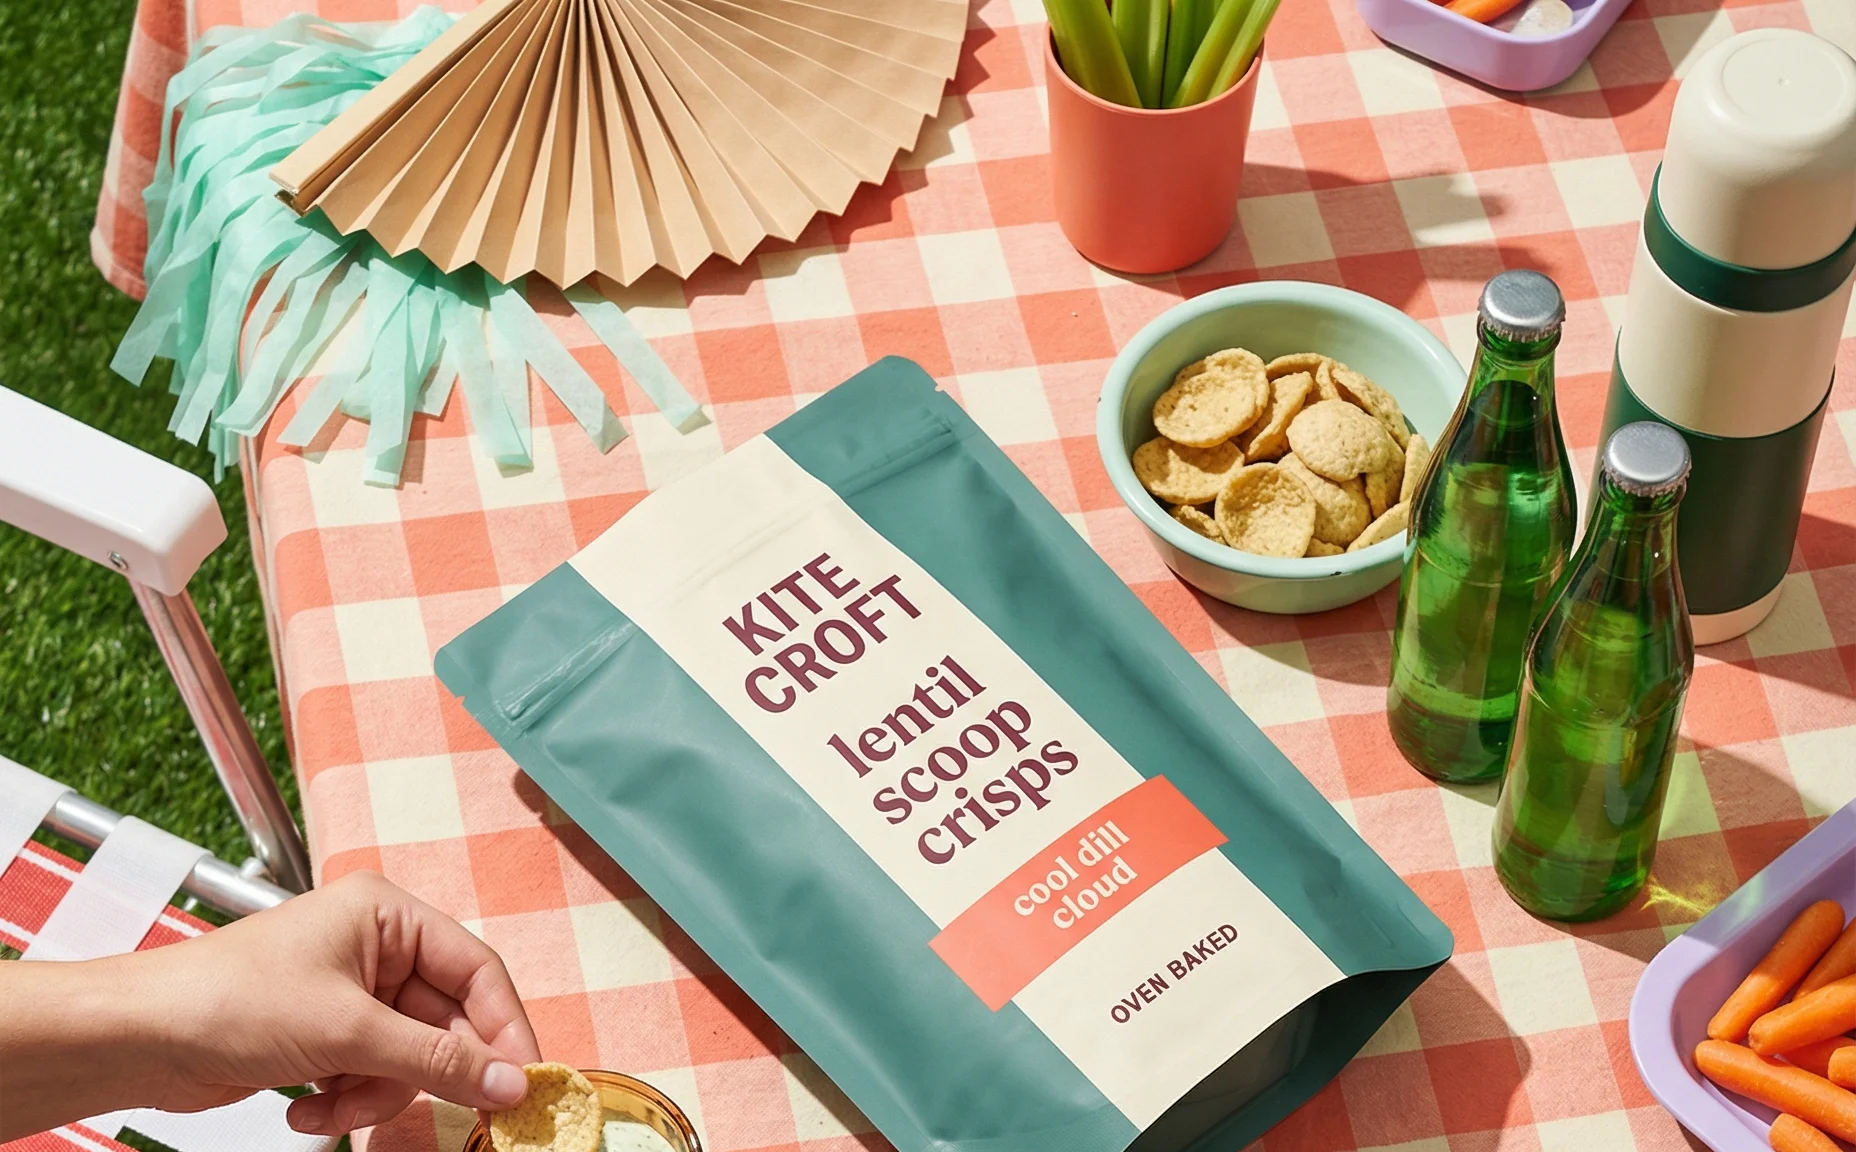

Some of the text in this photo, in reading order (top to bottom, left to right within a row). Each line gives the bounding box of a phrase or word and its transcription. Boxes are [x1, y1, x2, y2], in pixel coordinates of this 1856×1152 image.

[722, 552, 860, 656] KITE
[744, 574, 922, 713] CROFT
[826, 655, 986, 778] lentil
[872, 701, 1031, 825] scoop
[917, 740, 1079, 864] crisps
[1014, 820, 1130, 916] cool dill
[1053, 855, 1138, 929] cloud
[1110, 924, 1238, 1023] OVEN BAKED
